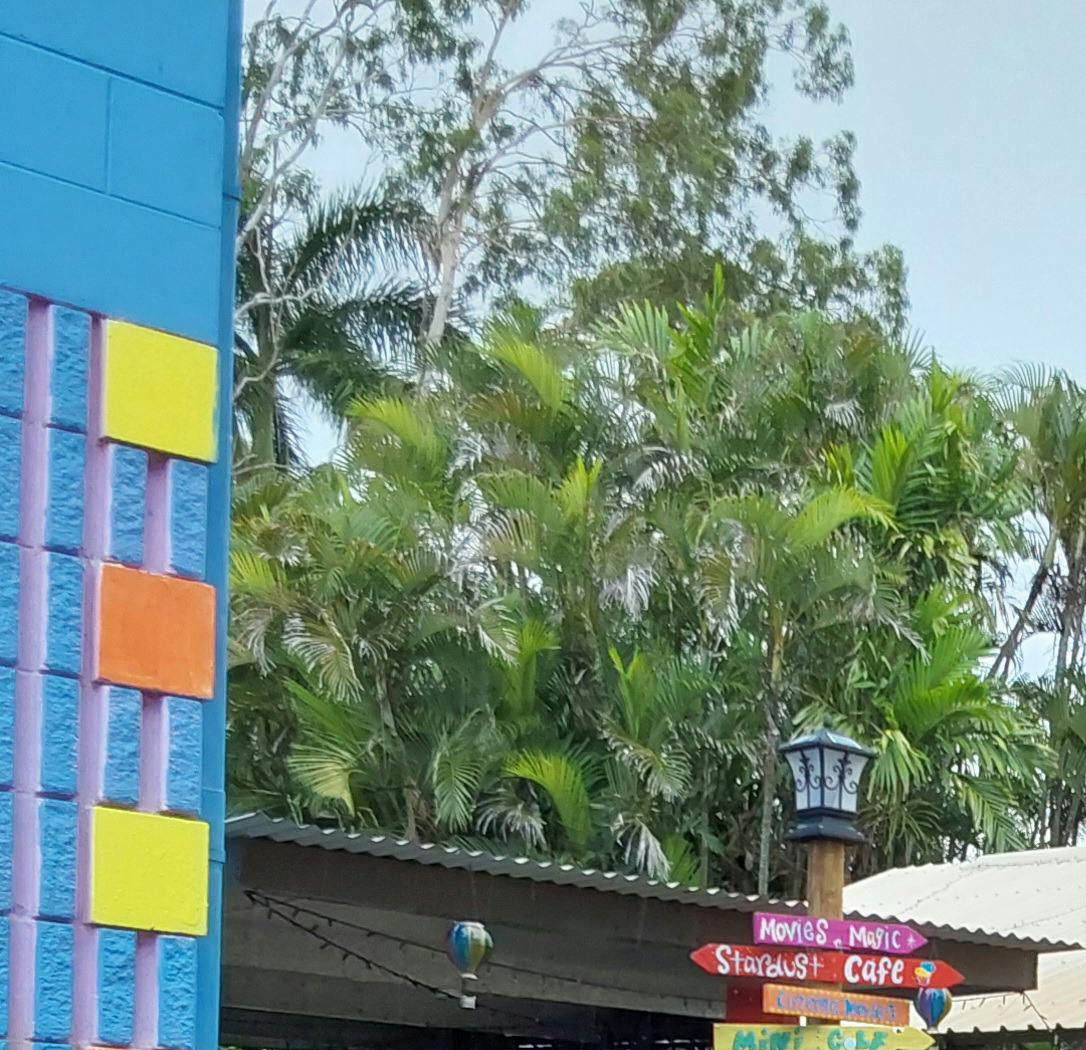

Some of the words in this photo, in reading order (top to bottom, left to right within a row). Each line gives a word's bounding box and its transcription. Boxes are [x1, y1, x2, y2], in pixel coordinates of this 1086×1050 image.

[759, 917, 828, 946] Movies
[849, 925, 901, 951] Magic
[715, 945, 824, 979] Stardust
[843, 955, 904, 985] Cafe
